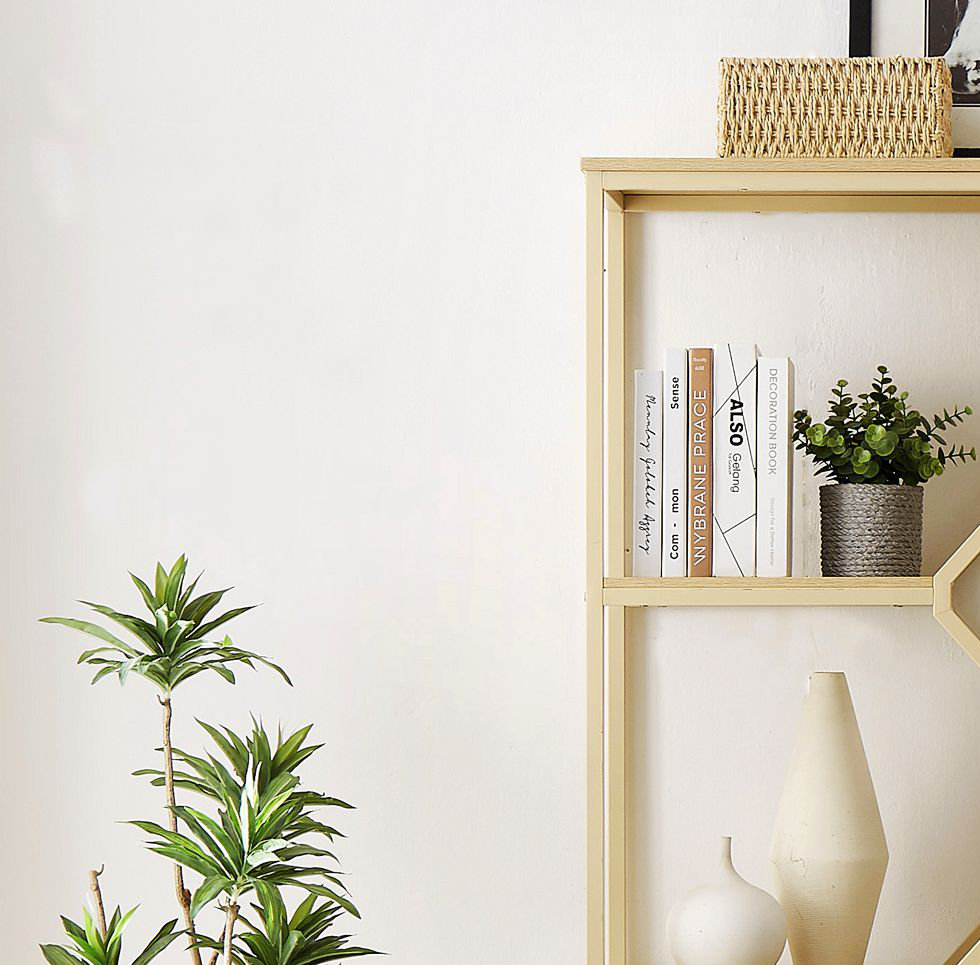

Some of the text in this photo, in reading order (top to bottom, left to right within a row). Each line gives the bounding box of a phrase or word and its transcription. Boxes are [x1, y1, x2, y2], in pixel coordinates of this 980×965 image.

[670, 376, 680, 410] Sense
[692, 389, 707, 458] PRACE
[729, 398, 744, 447] ALSO
[767, 368, 778, 475] DECORATION BOOK
[730, 452, 742, 493] Gelang
[671, 488, 680, 514] mon
[692, 463, 707, 567] WYBRANE
[669, 533, 680, 561] Com
